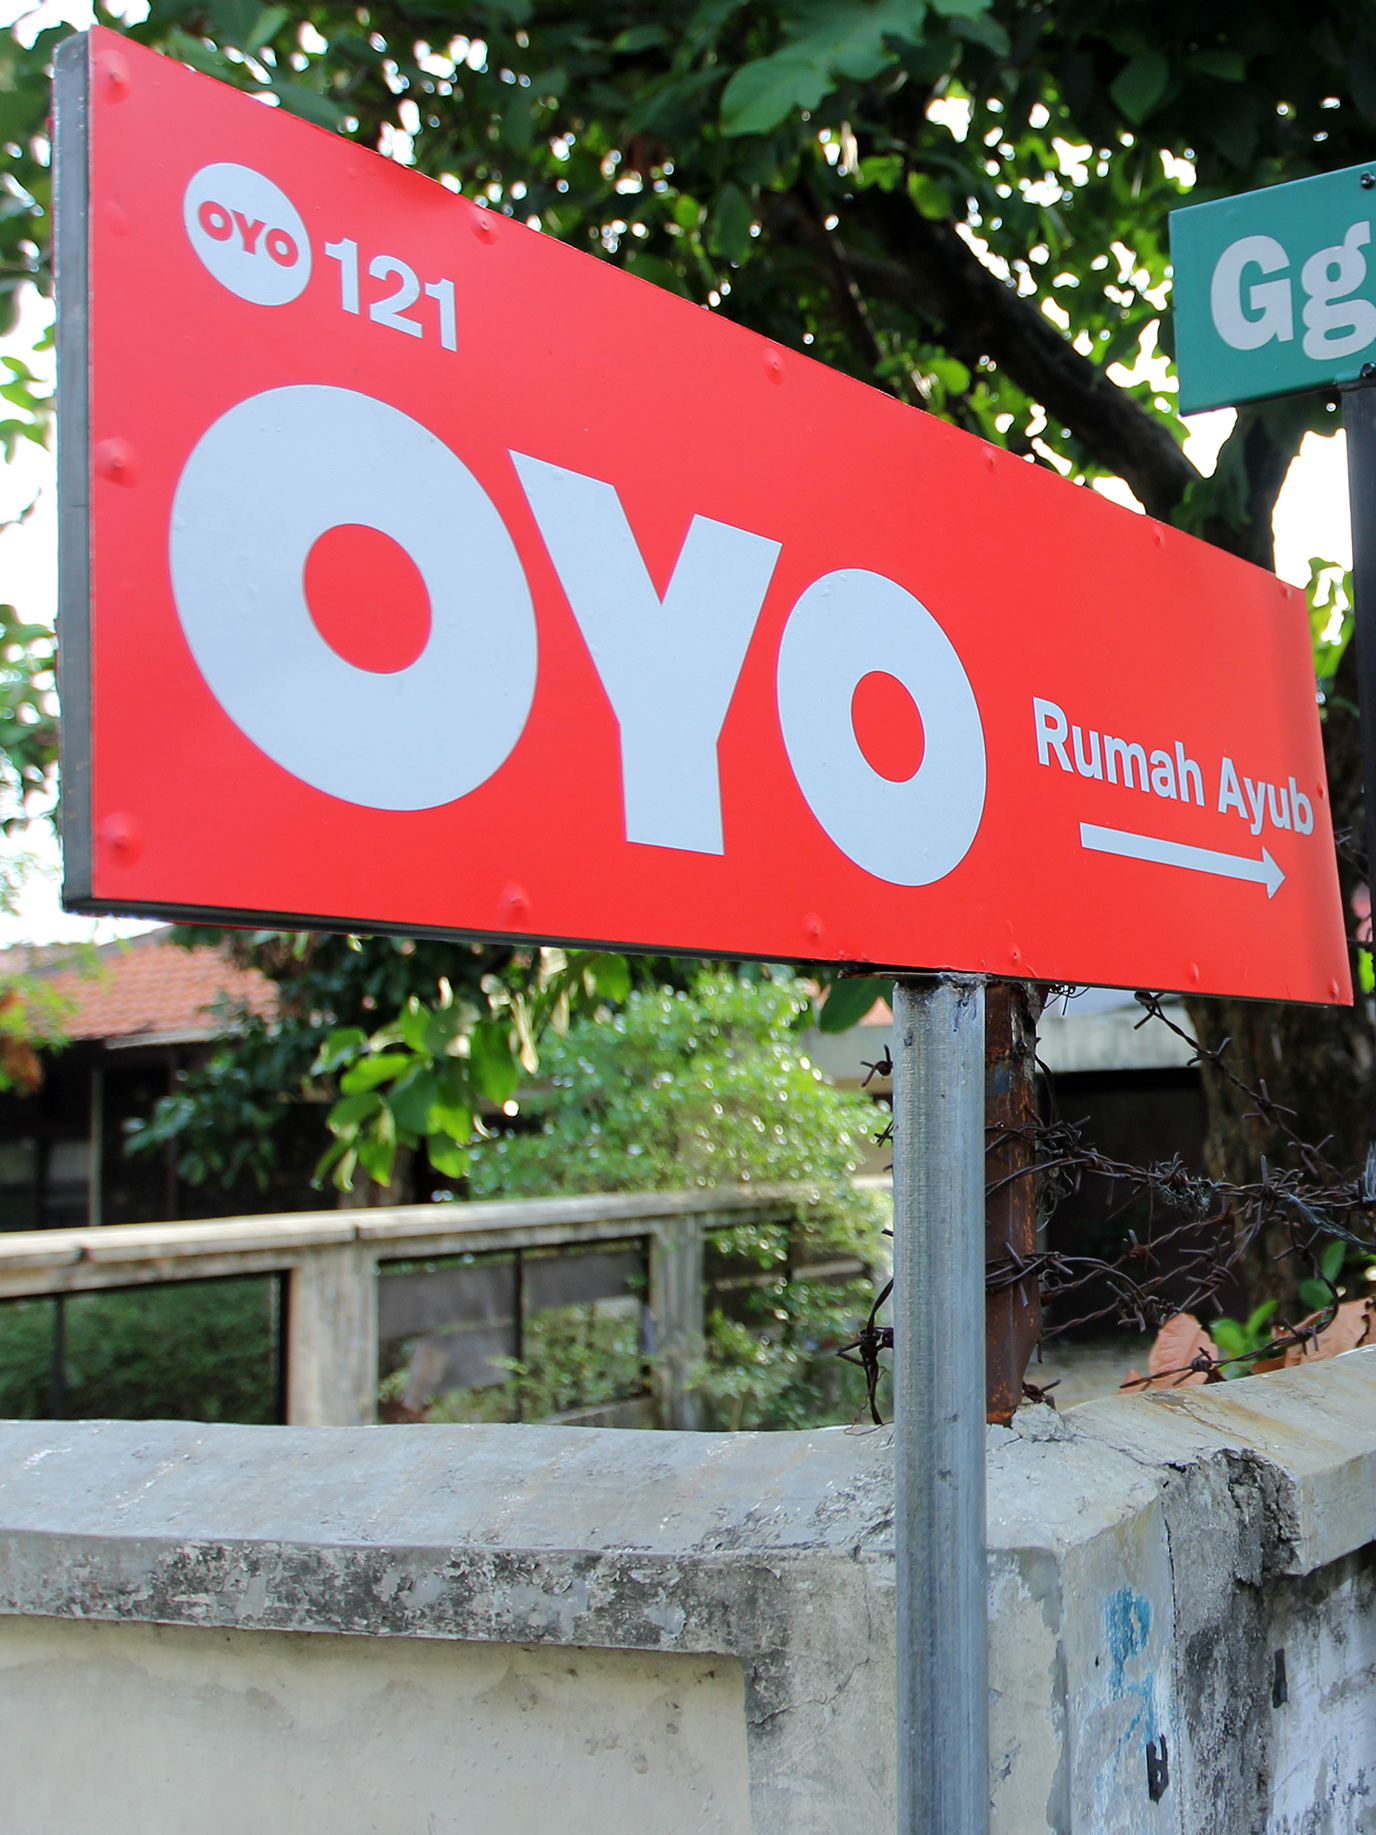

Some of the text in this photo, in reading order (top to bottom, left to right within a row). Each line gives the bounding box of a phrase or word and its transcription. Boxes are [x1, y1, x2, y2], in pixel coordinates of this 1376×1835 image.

[197, 200, 458, 353] OYO 121
[169, 384, 987, 887] OYO
[1033, 696, 1315, 836] Rumah Ayub
